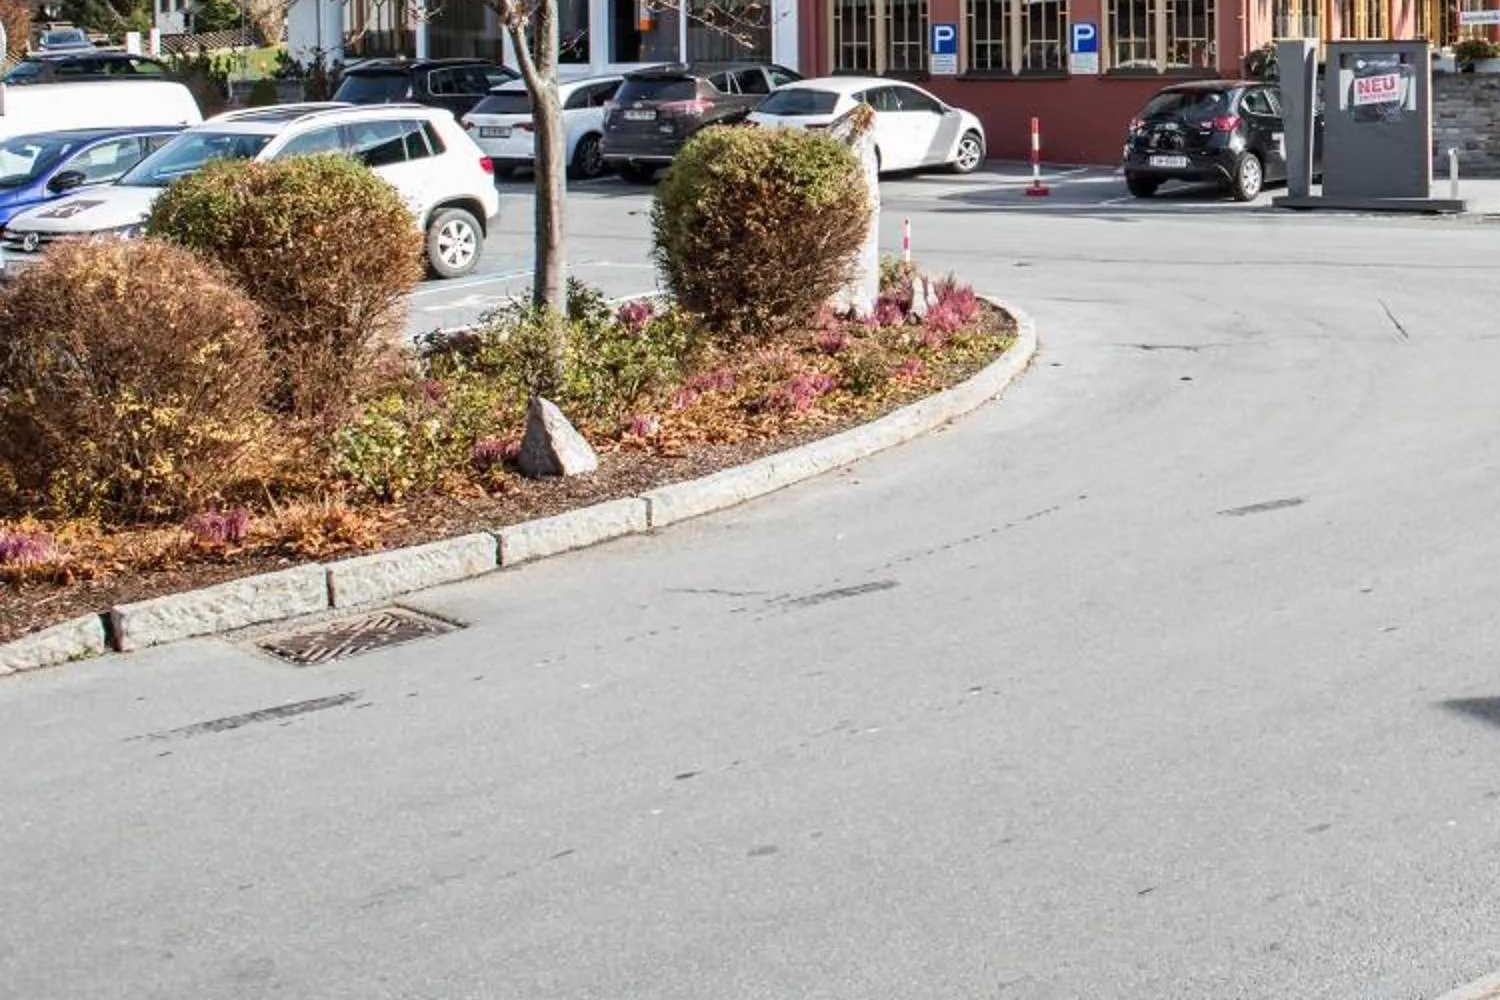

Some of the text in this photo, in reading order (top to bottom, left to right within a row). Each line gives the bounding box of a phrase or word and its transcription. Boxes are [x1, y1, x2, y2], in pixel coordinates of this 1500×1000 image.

[934, 25, 955, 53] P
[1074, 24, 1095, 52] P
[1357, 75, 1395, 94] NEU
